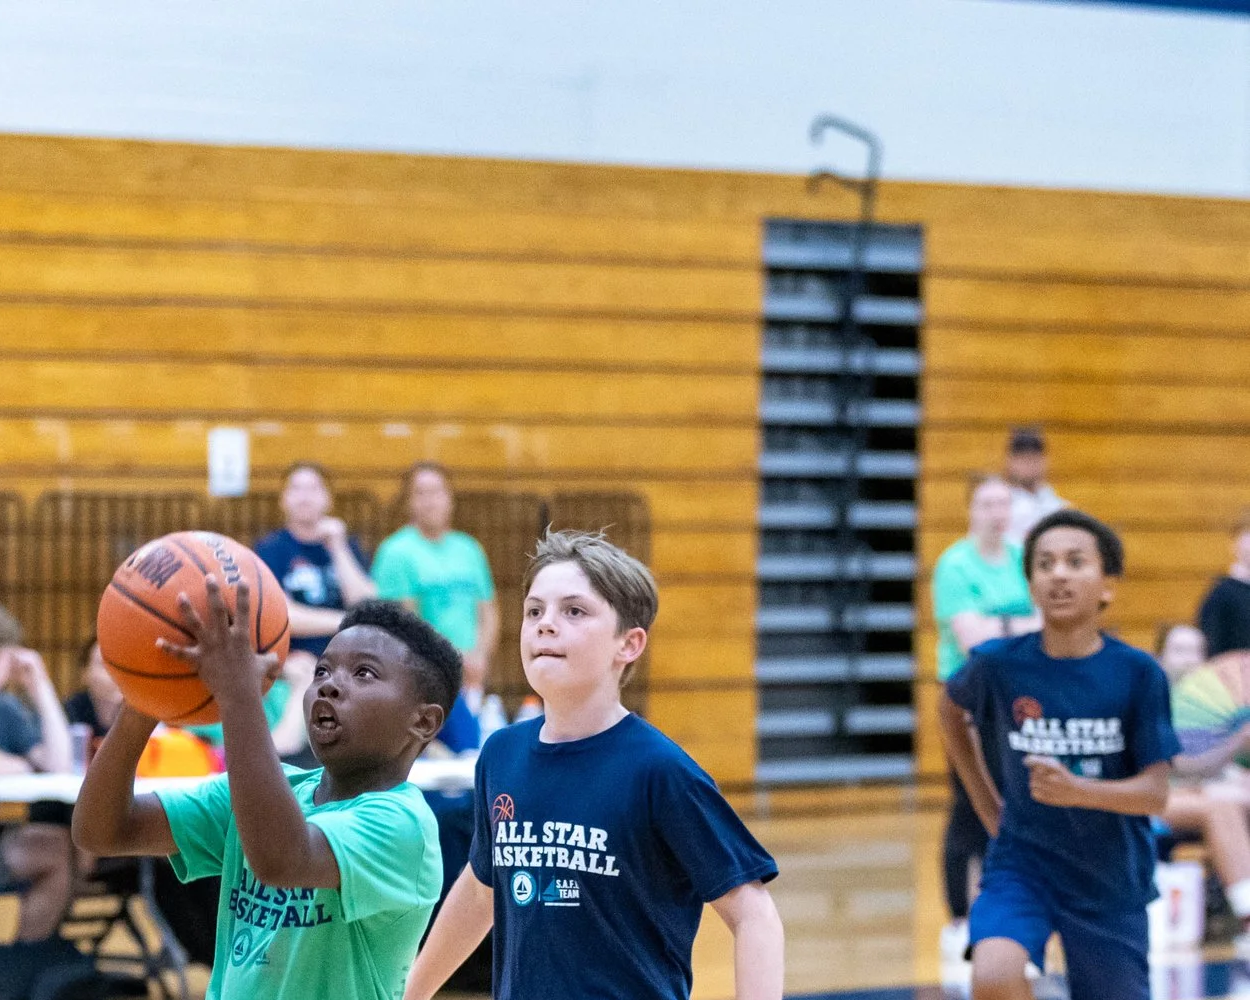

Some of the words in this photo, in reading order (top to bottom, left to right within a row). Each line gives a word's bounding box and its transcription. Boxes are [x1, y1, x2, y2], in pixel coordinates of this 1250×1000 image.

[495, 821, 538, 844] ALL
[542, 821, 609, 852] STAR
[493, 846, 620, 877] ASKETBALL
[229, 888, 333, 931] BSKETALL
[558, 889, 580, 899] TEAM
